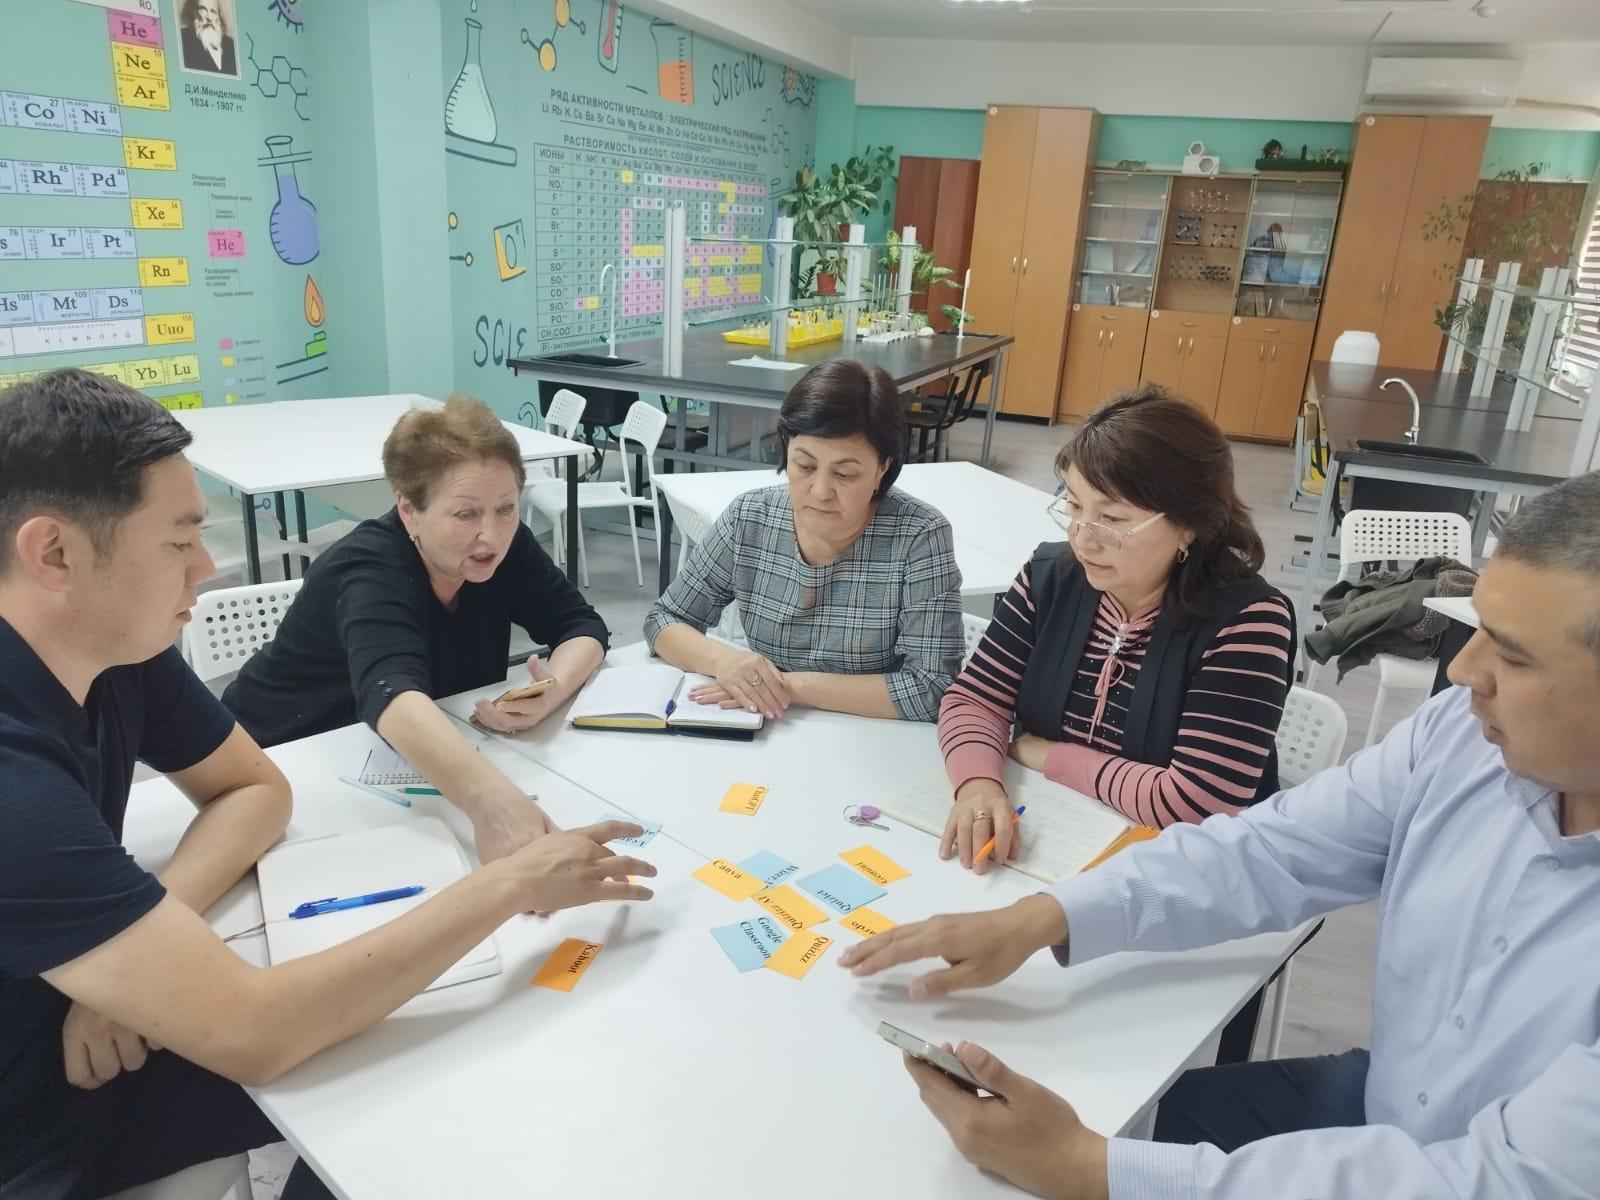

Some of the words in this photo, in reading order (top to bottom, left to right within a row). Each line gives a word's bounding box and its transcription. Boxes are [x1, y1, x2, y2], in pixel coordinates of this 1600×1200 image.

[120, 20, 147, 38] He
[153, 49, 162, 58] 10
[124, 53, 151, 70] Ne
[134, 85, 156, 100] Ar
[49, 98, 59, 108] 27
[109, 106, 118, 115] 28
[190, 97, 209, 109] 1834
[216, 101, 235, 112] 1907
[550, 88, 569, 103] РЯД
[571, 92, 624, 114] АКТИВНОСТИ
[625, 104, 664, 121] МЕТАЛЛОВ
[24, 103, 55, 120] Co
[82, 109, 107, 125] Ni
[552, 106, 562, 116] Rb
[565, 108, 571, 117] K
[627, 119, 637, 131] Mg
[564, 134, 636, 154] РАСТВОРИМОСТЬ
[137, 146, 156, 160] Kr
[540, 149, 565, 161] ИОНЫ
[59, 165, 69, 173] 45
[32, 170, 63, 185] Rh
[92, 173, 118, 188] Pd
[147, 207, 166, 221] Xe
[9, 229, 19, 237] 76
[68, 229, 77, 237] 77
[50, 234, 66, 248] Ir
[104, 234, 122, 248] Pt
[217, 239, 234, 251] He
[152, 264, 171, 277] Rn
[74, 290, 88, 300] 109
[109, 295, 129, 309] Ds
[0, 297, 18, 313] Hs
[52, 296, 78, 311] Mt
[157, 324, 184, 336] Uuo
[135, 367, 157, 381] Yb
[174, 364, 190, 376] Lu
[713, 860, 742, 880] Canva
[857, 862, 888, 885] Gemini
[818, 889, 851, 913] Quizlet
[773, 904, 803, 930] Quizizz
[758, 917, 782, 944] Google
[851, 921, 877, 936] ardo
[568, 944, 598, 973] Kahoot
